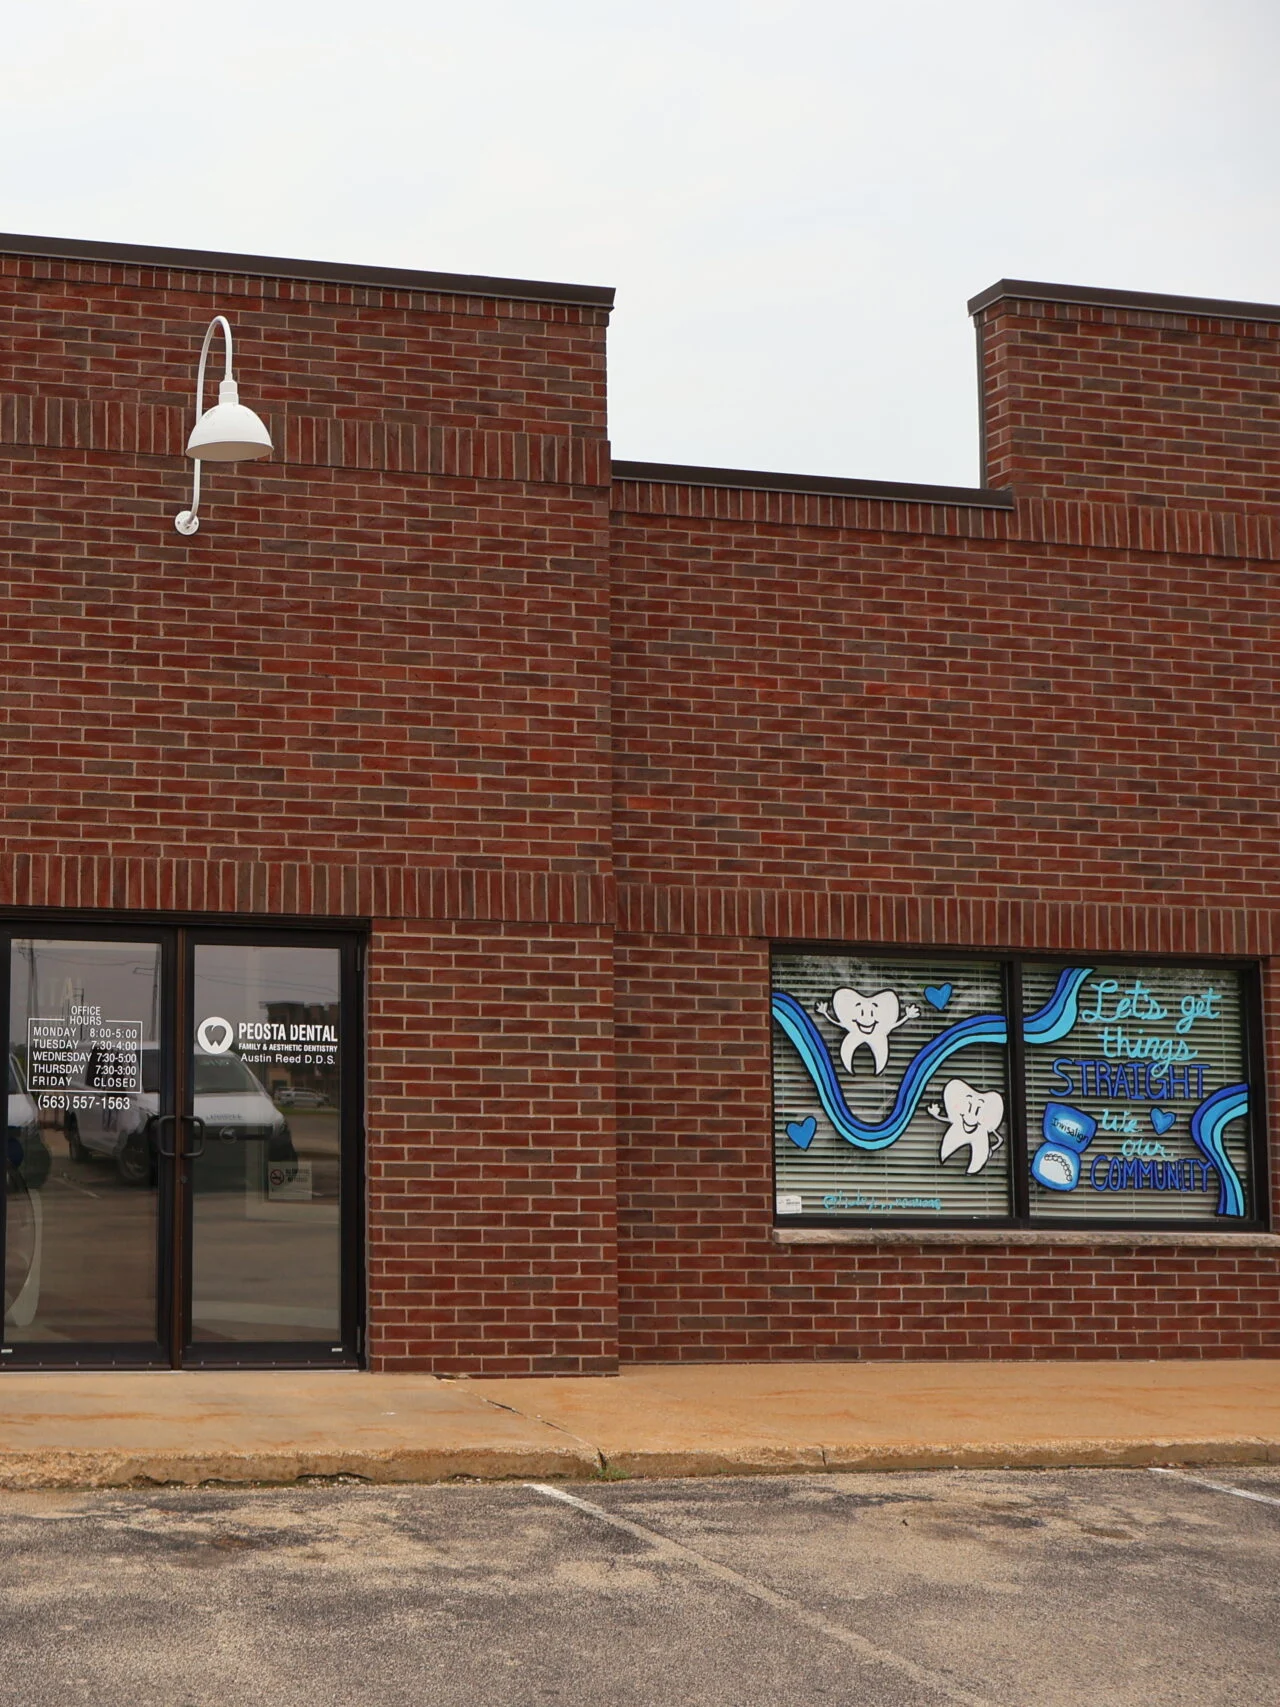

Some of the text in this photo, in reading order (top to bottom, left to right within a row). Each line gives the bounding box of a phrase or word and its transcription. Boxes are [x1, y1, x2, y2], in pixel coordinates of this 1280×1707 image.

[71, 1005, 101, 1016] OFFICE
[1081, 979, 1222, 1034] Let's get
[70, 1016, 102, 1026] HOURS
[33, 1026, 137, 1039] MONDAY 8:00-5:00
[238, 1022, 338, 1042] PEOSTA DENTAL
[33, 1038, 137, 1051] TUESDAY 7:30-4:00
[238, 1042, 338, 1052] FAMILY & AESTHETIC DENTISTRY
[32, 1051, 137, 1063] WEDNESDAY 7:30-5:00
[240, 1053, 335, 1064] Austin Reed D.D.S.
[1097, 1026, 1198, 1078] things
[32, 1064, 137, 1076] THURSDAY 7:30-3:00
[32, 1076, 136, 1088] FRIDAY CLOSED
[1049, 1058, 1211, 1100] STRAIGHT
[37, 1094, 130, 1111] (563) 557-1563
[1090, 1155, 1214, 1193] COMMUNITY
